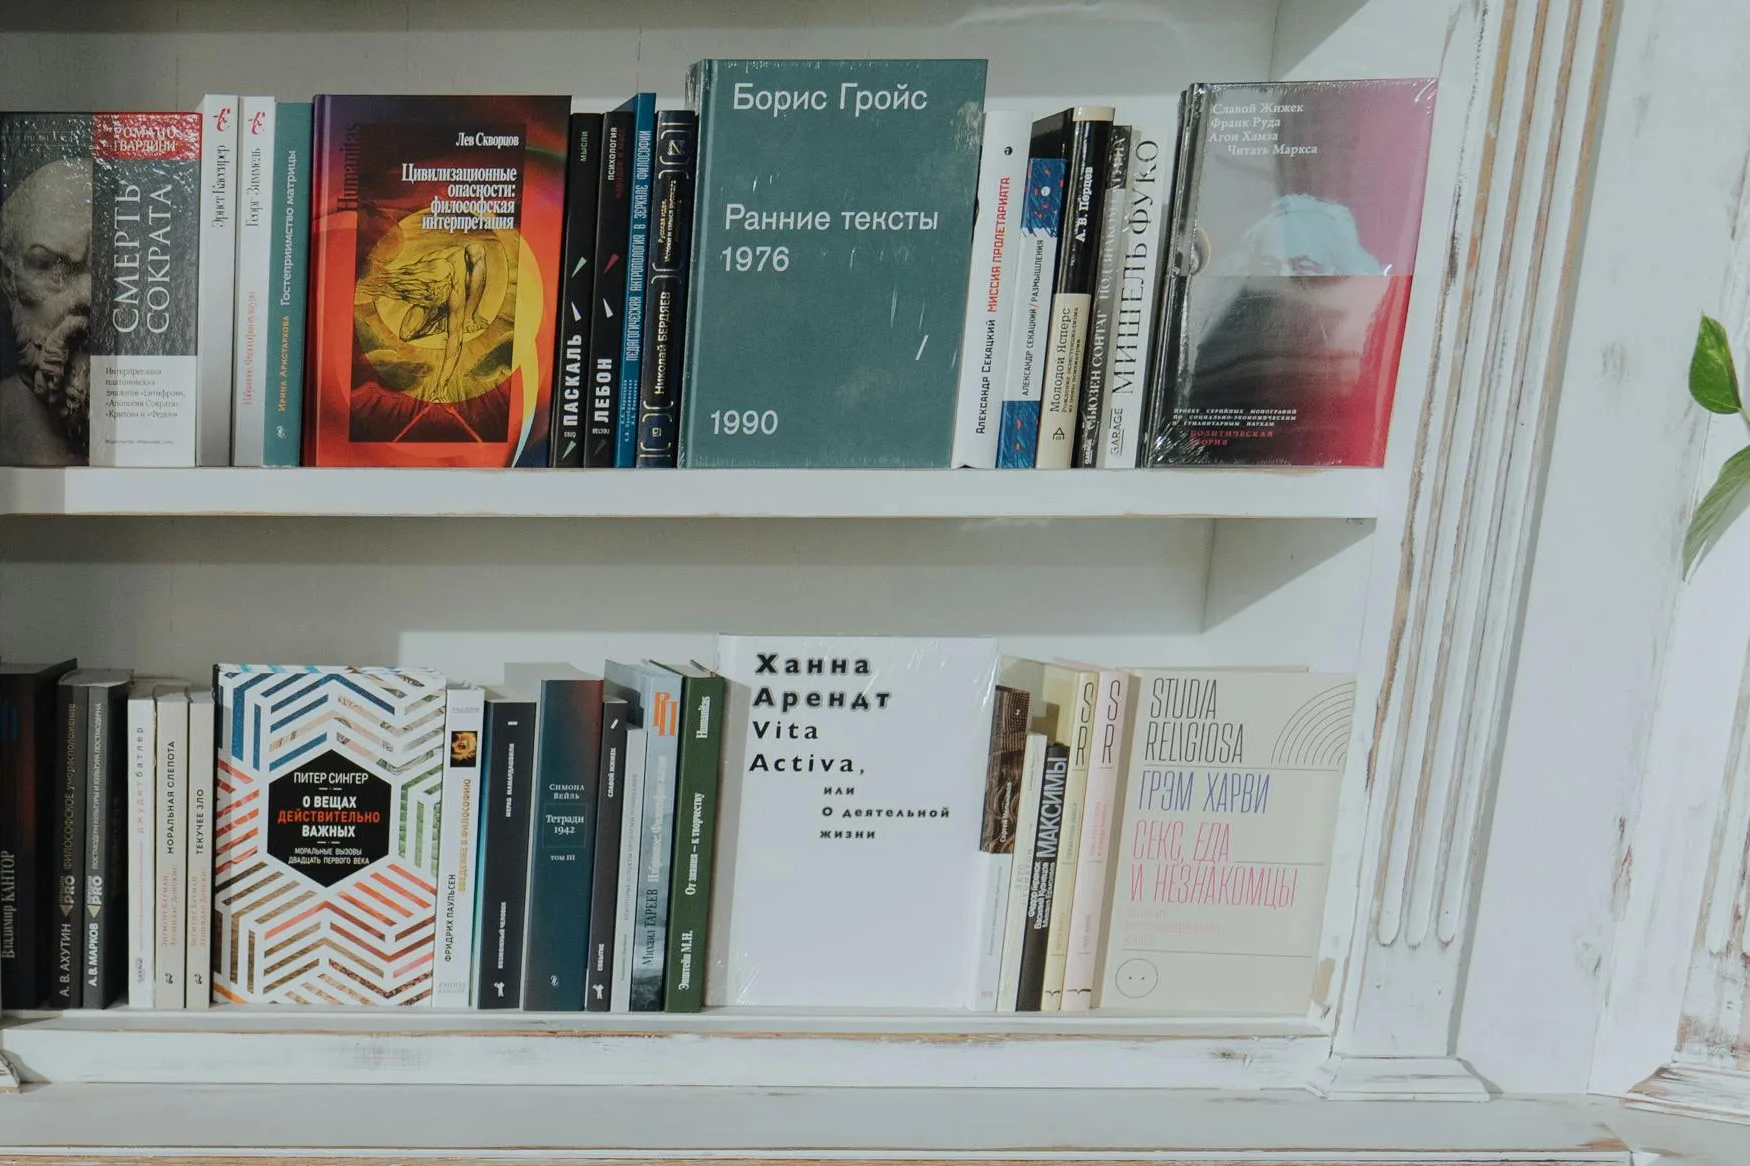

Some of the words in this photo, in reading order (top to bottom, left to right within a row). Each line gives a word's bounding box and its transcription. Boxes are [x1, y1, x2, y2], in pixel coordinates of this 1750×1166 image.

[733, 83, 827, 117] Борис
[839, 83, 928, 117] Гройс
[456, 132, 474, 147] Лев
[476, 132, 519, 147] Скворцов
[402, 163, 517, 182] Цивилизационные
[447, 182, 516, 198] опасности:
[430, 197, 515, 215] философская
[725, 203, 831, 230] Ранние
[841, 212, 938, 230] тексты
[422, 214, 514, 232] интерпретация
[993, 177, 1010, 262] ПРОЛЕТАРИАТА
[113, 184, 141, 333] СМЕРТЬ
[147, 184, 172, 333] СОКРАТА
[722, 247, 790, 272] 1976
[1112, 242, 1148, 396] МИШЕЛЬ
[1130, 140, 1158, 235] ФУКО
[987, 265, 1001, 313] МИССИЯ
[563, 334, 582, 427] ПАСКАЛЬ
[594, 358, 612, 423] ЛЕБОН
[711, 410, 778, 435] 1990
[755, 654, 870, 675] Ханна
[753, 687, 890, 712] Арендт
[1150, 677, 1218, 720] STUDIA
[752, 721, 818, 739] Vita
[1145, 721, 1244, 764] RELIGIOSA
[749, 754, 865, 775] Activa,
[294, 773, 327, 784] ПИТЕР
[328, 773, 369, 785] СИНГЕР
[824, 786, 855, 795] или
[303, 797, 311, 807] О
[314, 797, 356, 809] ВЕЩАХ
[1139, 771, 1194, 811] ГРЭМ
[1203, 773, 1271, 815] ХАРВИ
[278, 811, 380, 824] ДЕЙСТВИТЕЛЬНО
[842, 807, 949, 819] деятельной
[1036, 757, 1067, 858] МАКСИМЫ
[302, 825, 355, 837] ВАЖНЫХ
[820, 830, 875, 839] жизни
[1133, 820, 1185, 864] СЕКС,
[1193, 822, 1231, 865] ЕДА
[1130, 863, 1143, 902] И
[1154, 864, 1298, 910] НЕЗНАКОМЦЫ
